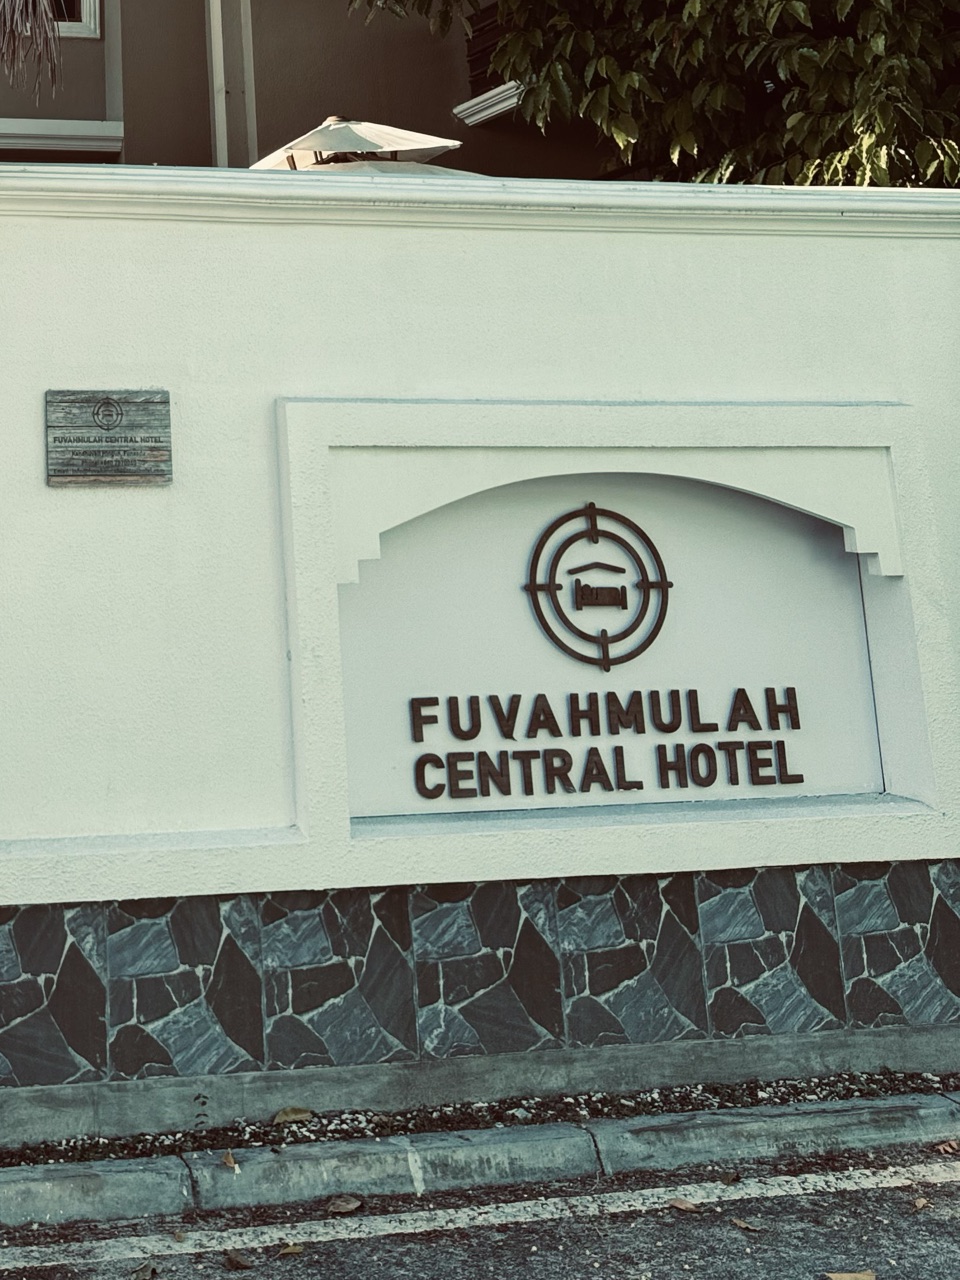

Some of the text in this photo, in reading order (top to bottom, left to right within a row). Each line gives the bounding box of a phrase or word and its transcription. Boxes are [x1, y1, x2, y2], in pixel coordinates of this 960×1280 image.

[53, 436, 163, 444] FUVAHMULAH CENTRAL HOTEL
[410, 686, 801, 743] FUVAHMULAH
[415, 740, 805, 799] CENTRAL HOTEL
